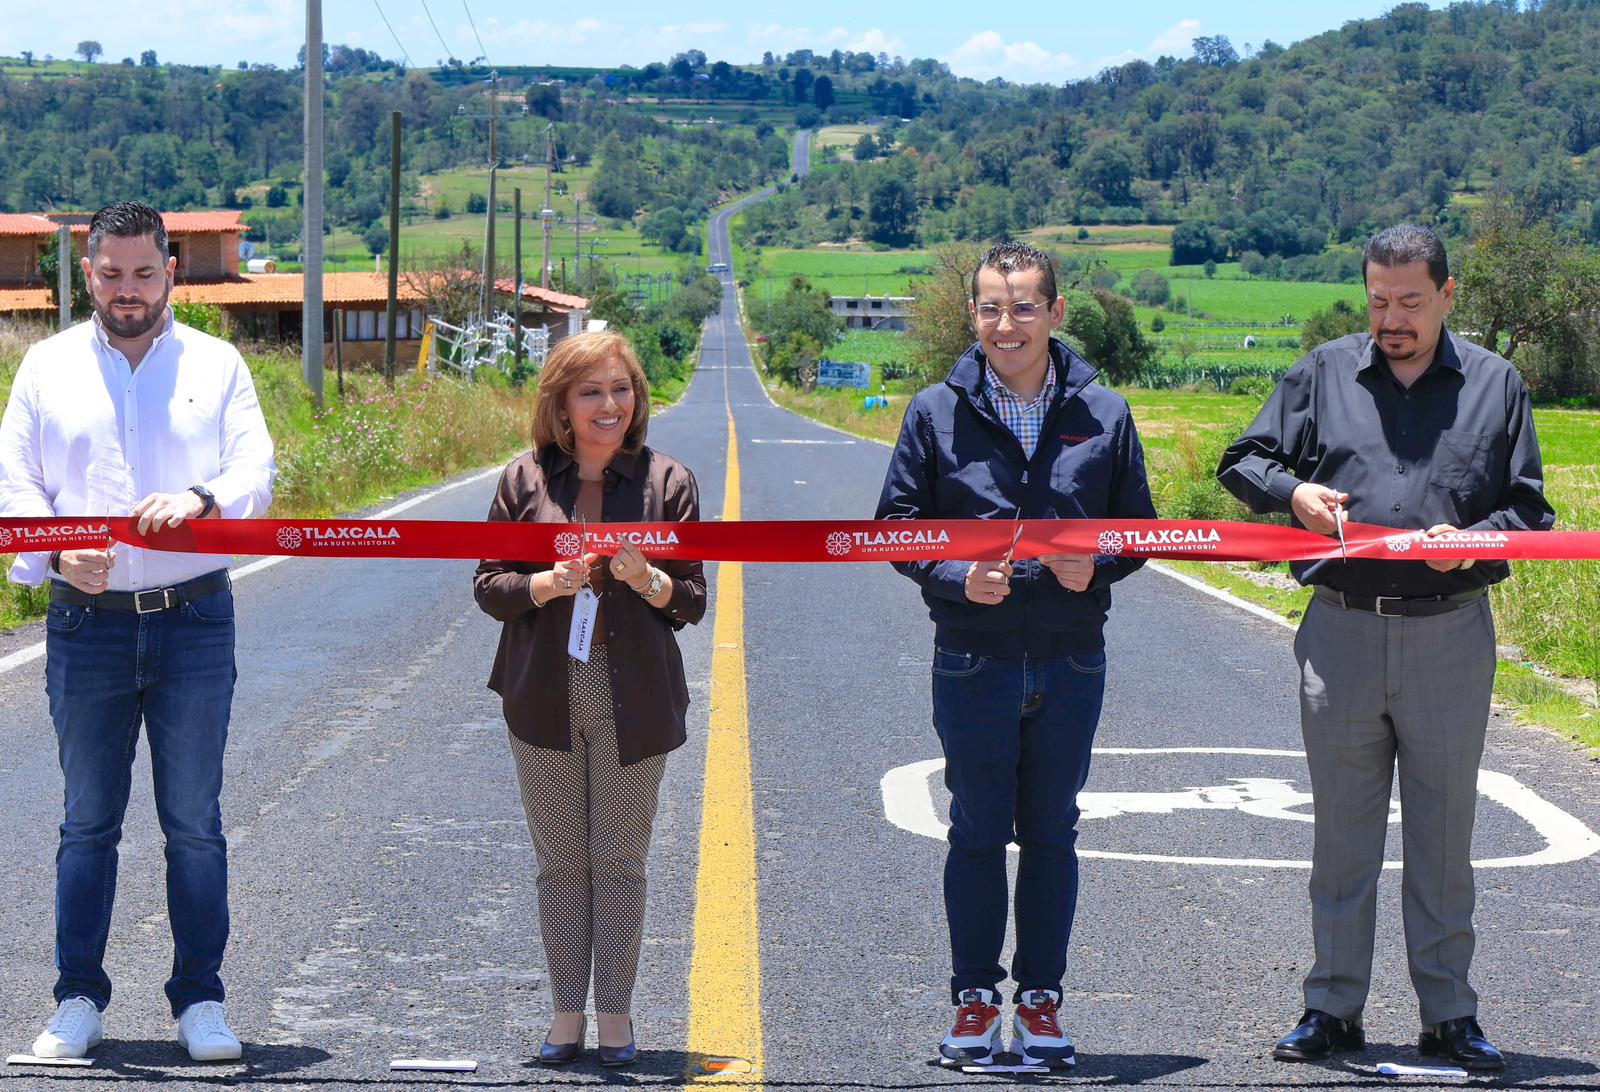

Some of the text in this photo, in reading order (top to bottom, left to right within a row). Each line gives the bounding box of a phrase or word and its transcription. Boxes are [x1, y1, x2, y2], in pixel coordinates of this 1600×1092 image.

[12, 524, 109, 538] TLAXCALA
[303, 527, 400, 539] TLAXCALA
[852, 529, 950, 546] TLAXCALA
[1123, 528, 1221, 545] TLAXCALA
[578, 618, 588, 651] TLAXCALA
